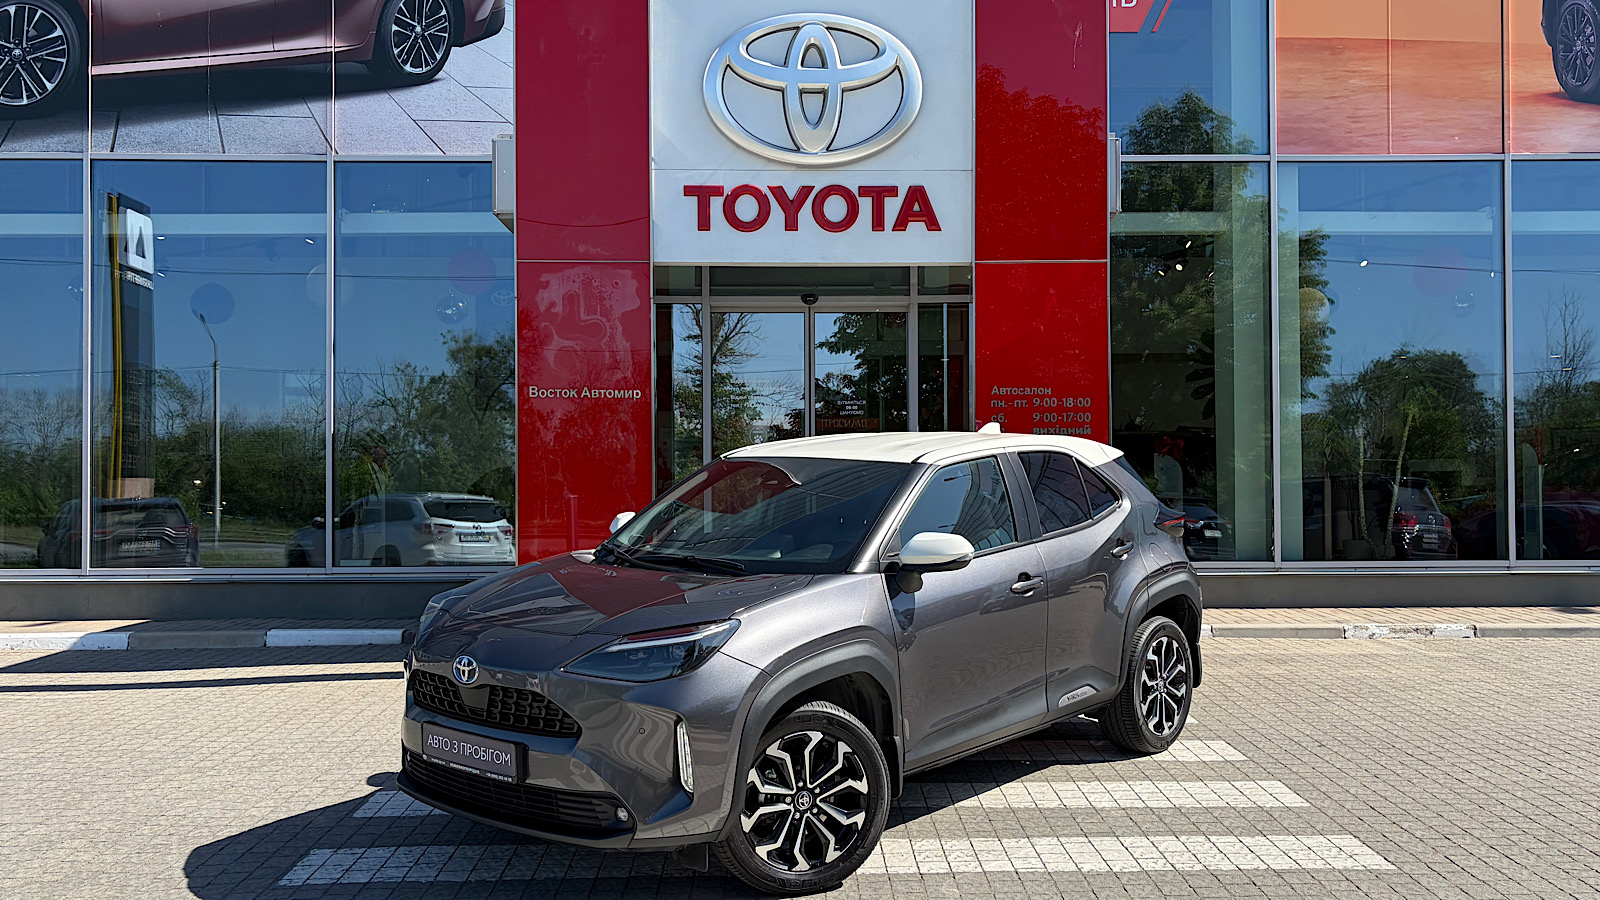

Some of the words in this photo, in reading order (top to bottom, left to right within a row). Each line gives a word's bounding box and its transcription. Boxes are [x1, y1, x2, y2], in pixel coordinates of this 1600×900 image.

[684, 184, 942, 233] TOYOTA
[529, 386, 578, 398] Восток
[581, 387, 641, 402] Автомир
[991, 385, 1052, 395] Автосалон
[1033, 397, 1091, 407] 9:00-18:00
[991, 413, 1008, 423] сб.
[1033, 412, 1091, 422] 9:00-17:00
[1033, 425, 1091, 435] вихідний
[427, 734, 451, 751] АВТО
[452, 740, 459, 753] З
[460, 742, 511, 767] ПРОБІГОМ
